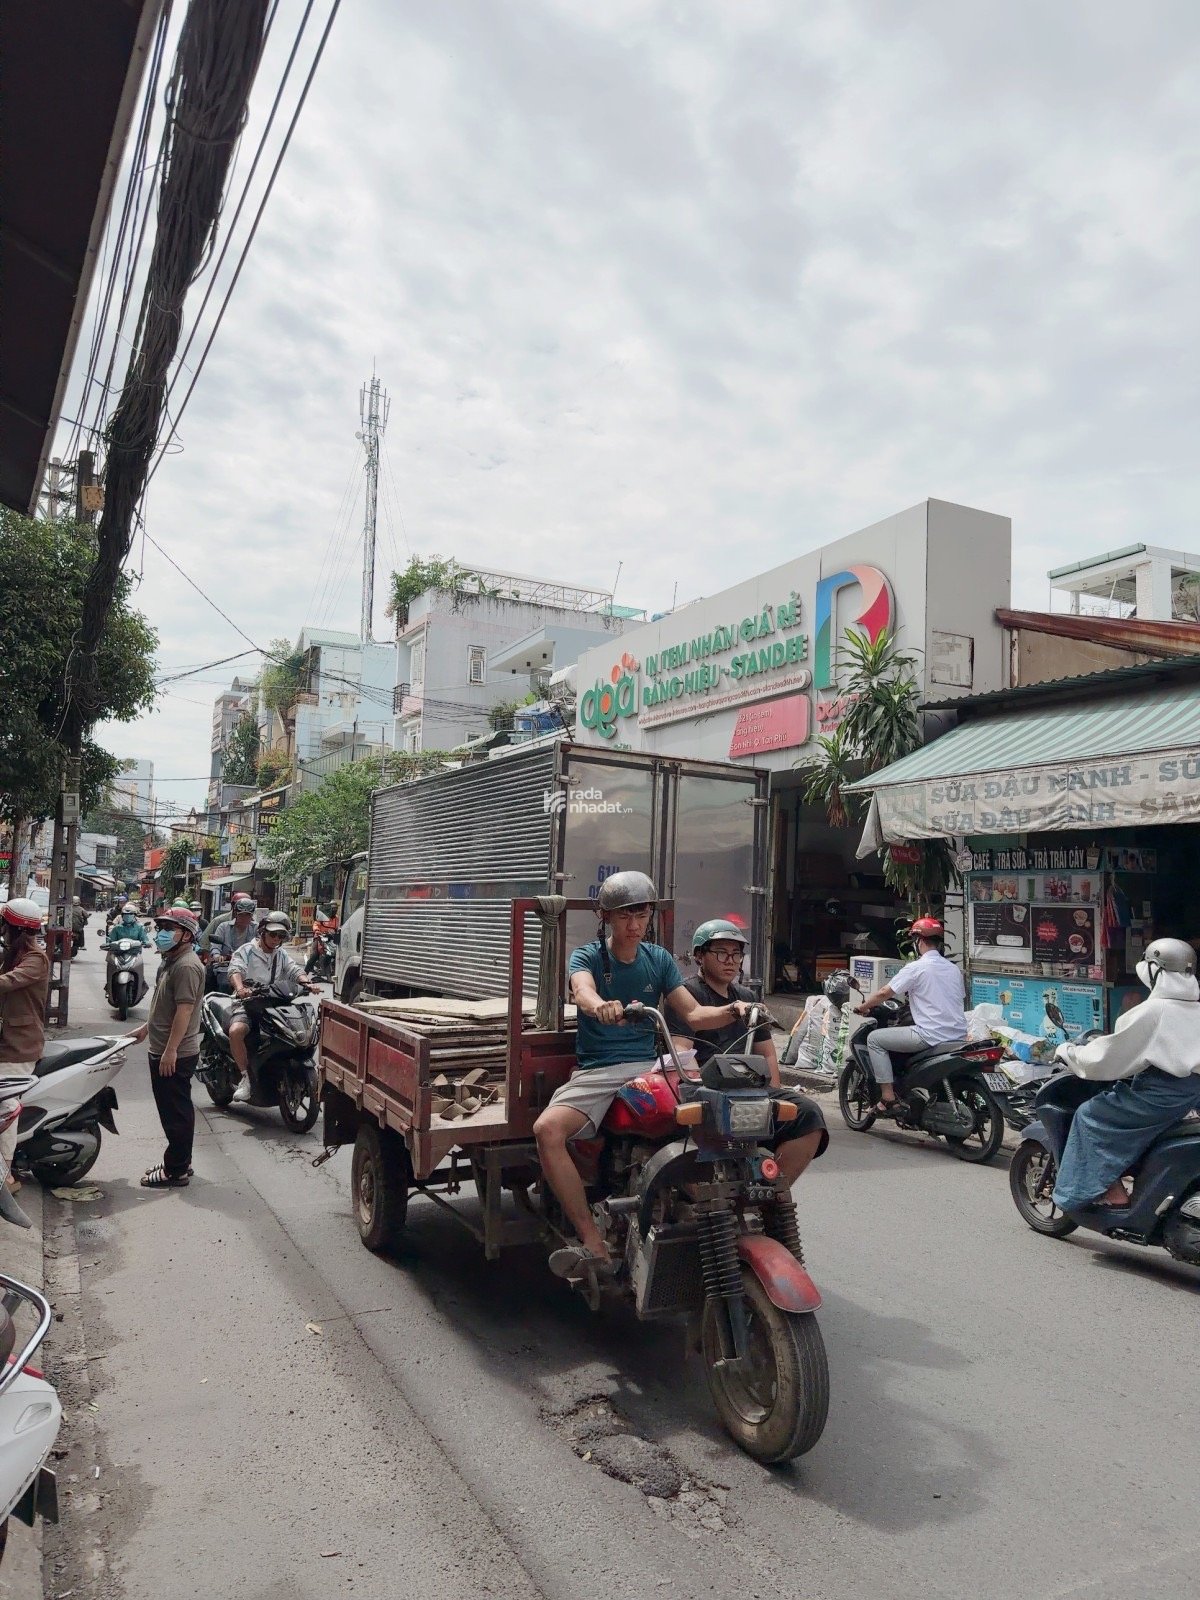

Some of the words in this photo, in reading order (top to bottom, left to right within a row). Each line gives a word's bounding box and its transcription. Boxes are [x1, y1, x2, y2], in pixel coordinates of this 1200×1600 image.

[645, 652, 661, 676] IN
[661, 642, 690, 670] TEM
[739, 603, 775, 642] GIÁ
[777, 591, 802, 630] RẺ
[643, 675, 684, 706] BẢNG
[684, 662, 720, 695] HIỆU
[730, 634, 809, 680] STANDEE
[930, 781, 978, 804] SỮA
[984, 774, 1040, 801] ĐẬU
[930, 809, 974, 832] SỮA
[980, 805, 1032, 832] ĐẬU
[973, 849, 990, 871] CAFÉ
[998, 849, 1011, 870] TRÀ
[1034, 847, 1048, 869] TRÀ
[1049, 846, 1067, 869] TRÁI
[1068, 846, 1085, 868] CÂY
